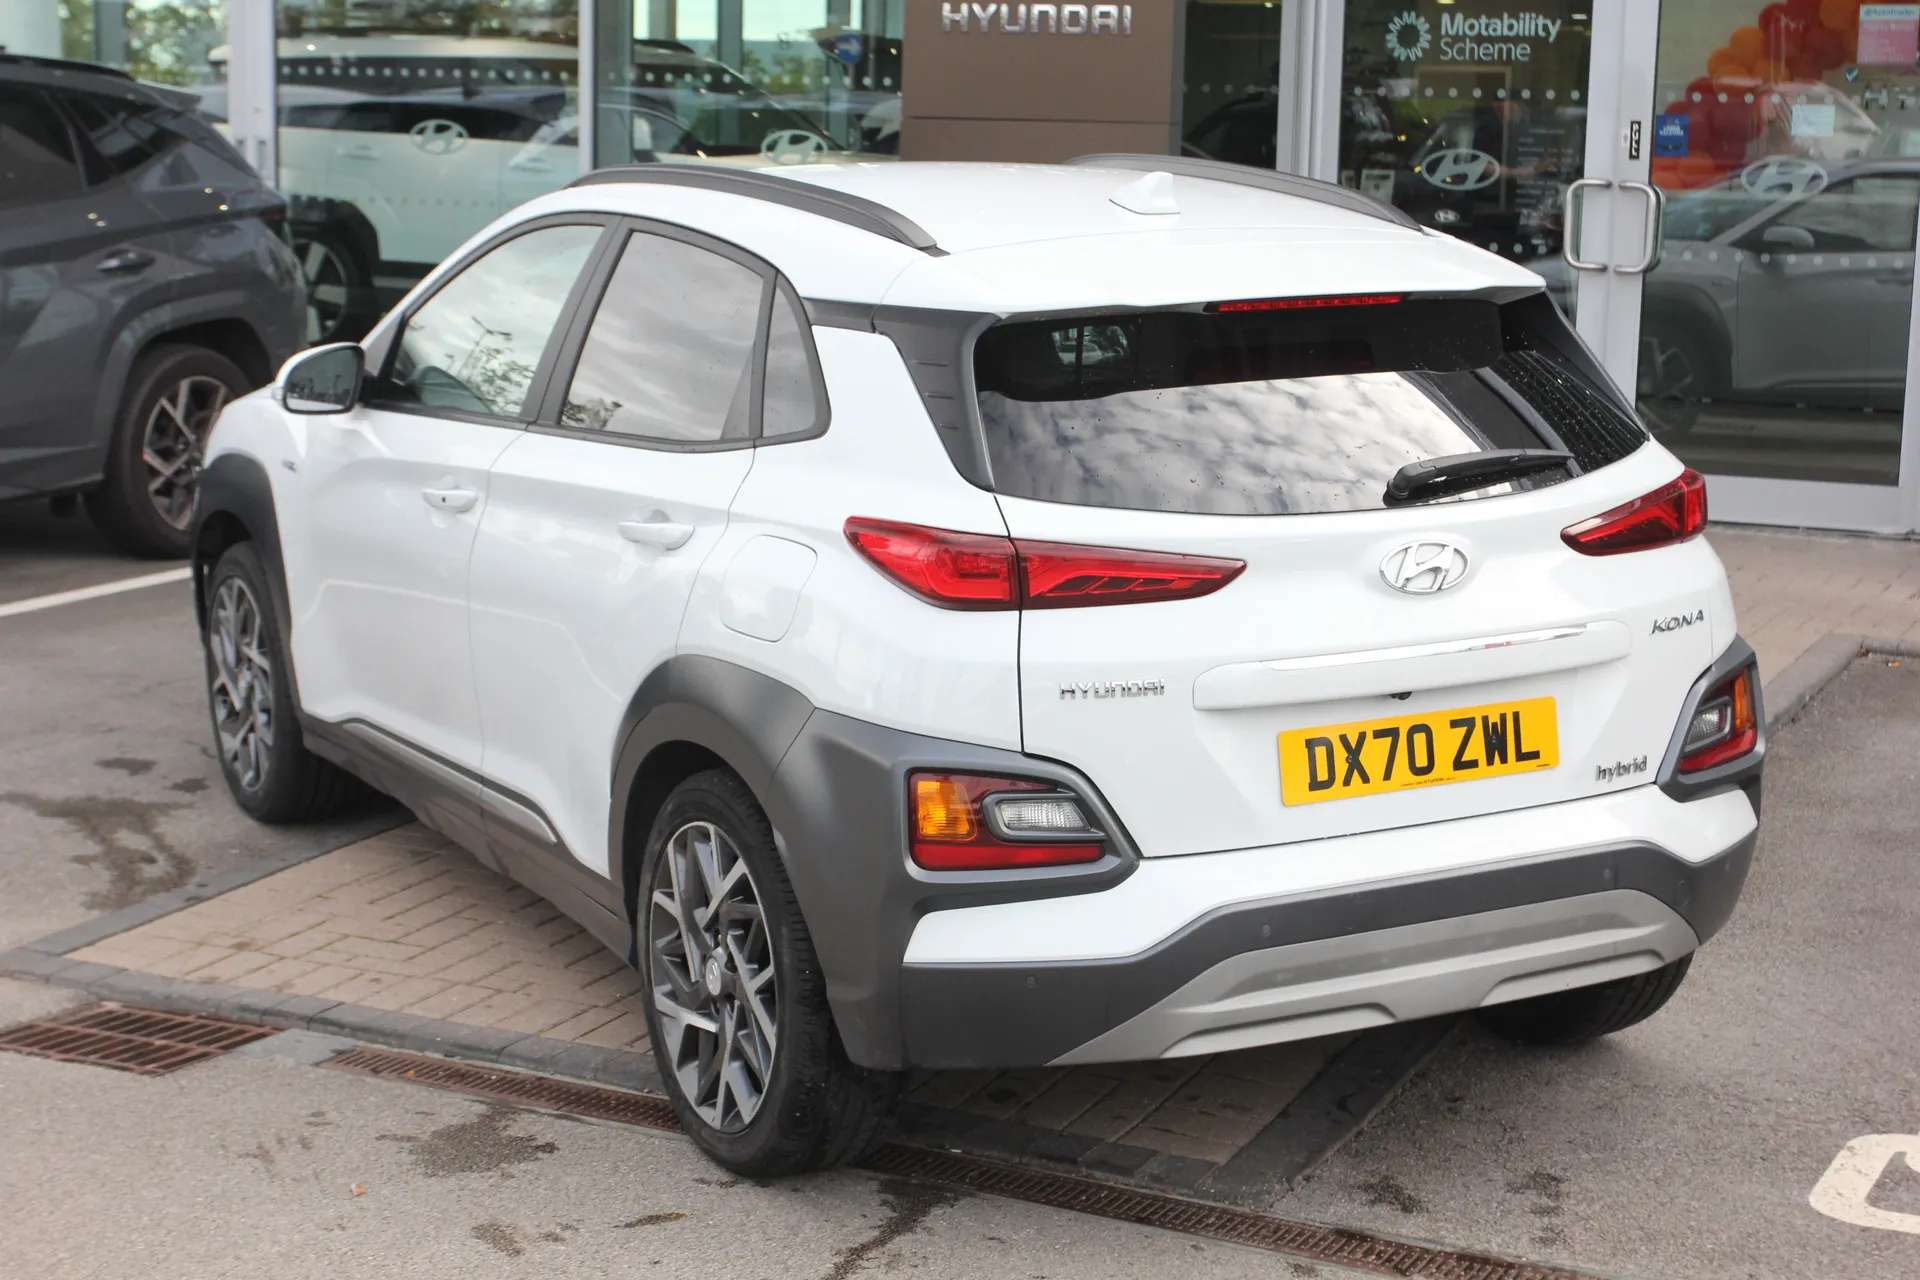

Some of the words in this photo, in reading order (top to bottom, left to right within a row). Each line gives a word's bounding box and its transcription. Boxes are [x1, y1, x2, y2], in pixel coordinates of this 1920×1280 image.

[941, 2, 1132, 34] HYUNDAI
[1440, 12, 1561, 42] Motability
[1440, 38, 1531, 61] Scheme
[1650, 609, 1704, 635] KONA
[1060, 679, 1165, 700] HYUNDAI
[1305, 723, 1435, 792] DX70
[1449, 711, 1541, 771] ZWL
[1595, 755, 1648, 783] hybrid
